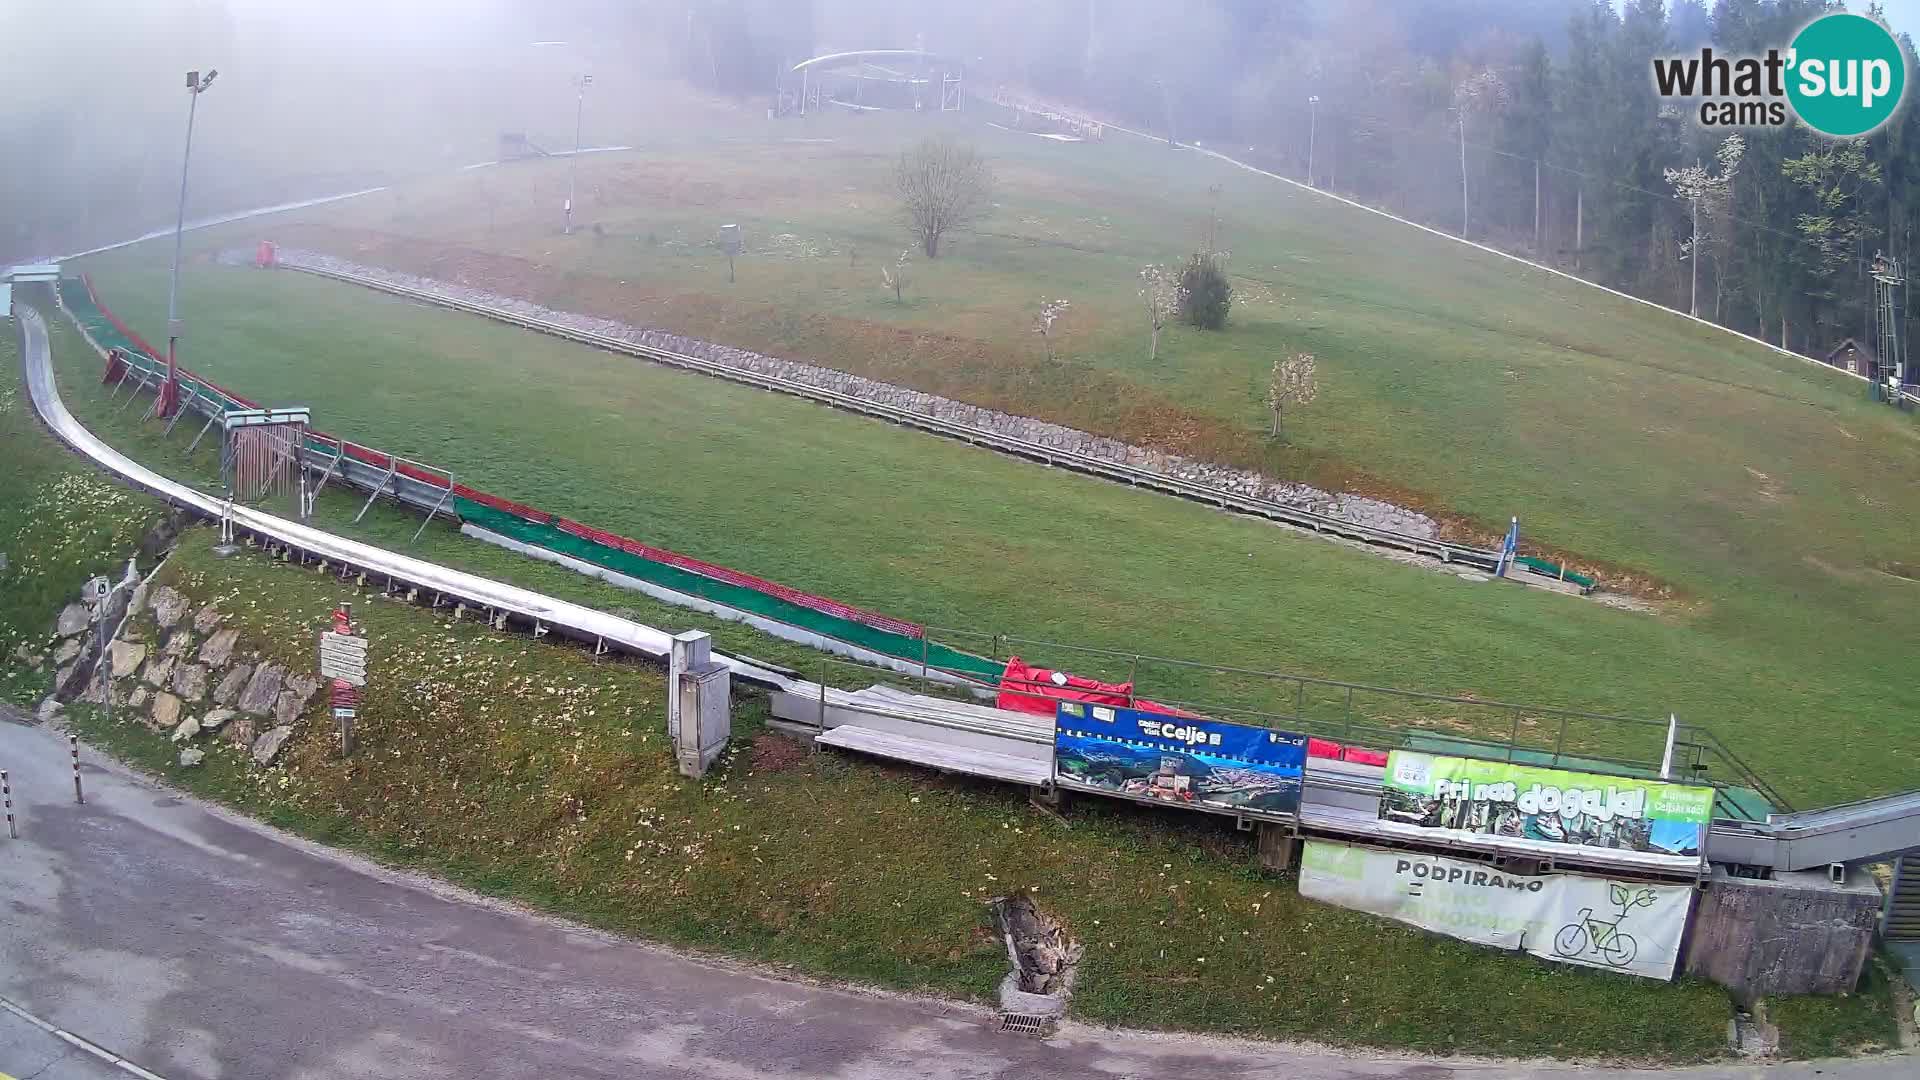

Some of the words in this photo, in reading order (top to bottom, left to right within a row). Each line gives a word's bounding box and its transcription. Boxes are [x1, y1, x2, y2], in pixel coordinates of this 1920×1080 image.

[1161, 723, 1206, 745] Celje
[1474, 780, 1517, 802] nas
[1517, 783, 1646, 822] dogaja!
[1395, 859, 1544, 892] PODPIRAMO
